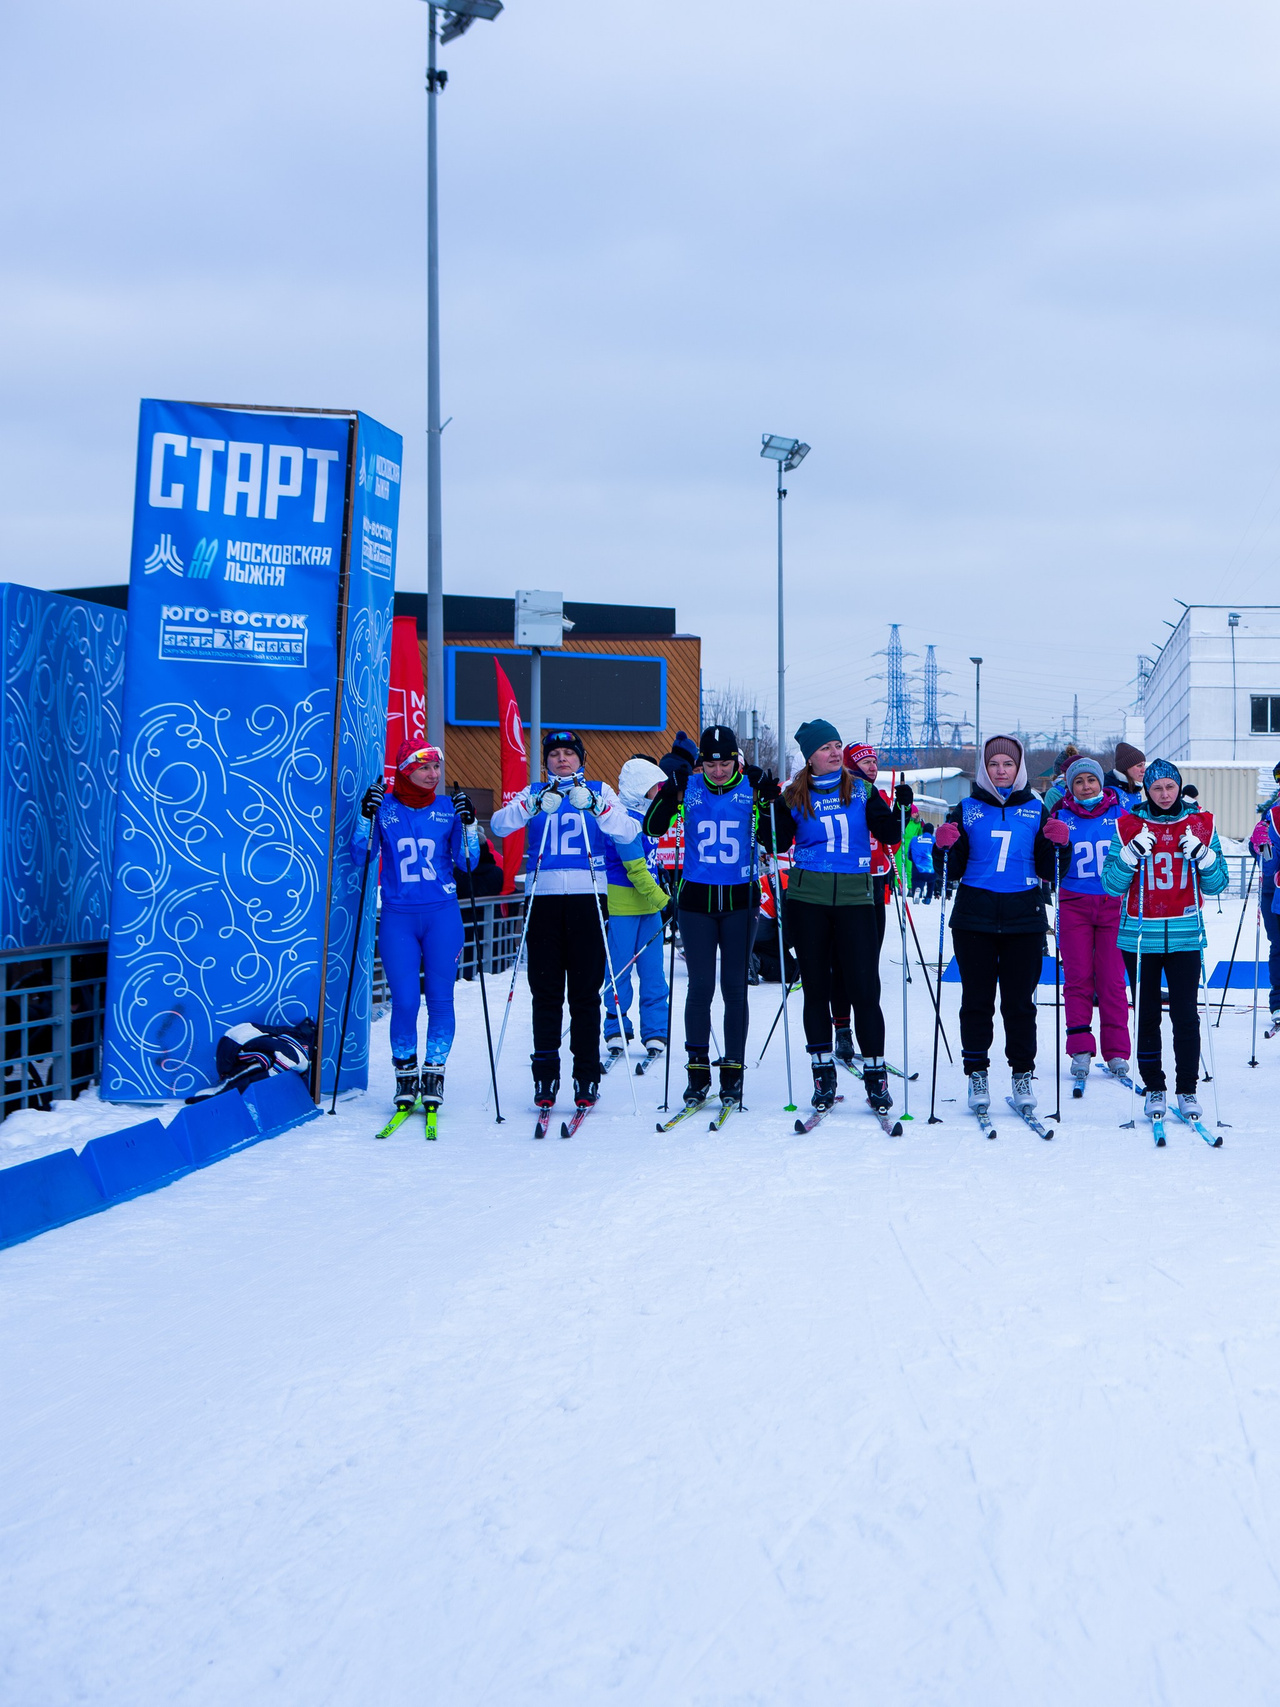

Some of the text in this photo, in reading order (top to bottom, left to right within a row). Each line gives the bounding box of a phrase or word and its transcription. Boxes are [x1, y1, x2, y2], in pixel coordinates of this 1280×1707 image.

[149, 432, 339, 523] СТАРТ
[226, 539, 332, 567] МОСКОВСКАЯ
[223, 563, 286, 587] ЛЫЖНЯ
[161, 605, 308, 629] ЮГО-ВОСТОК
[550, 813, 582, 855] 12
[697, 820, 740, 864] 25
[820, 813, 850, 853] 11
[990, 830, 1012, 872] 7
[397, 837, 437, 883] 23
[1146, 851, 1190, 891] 137
